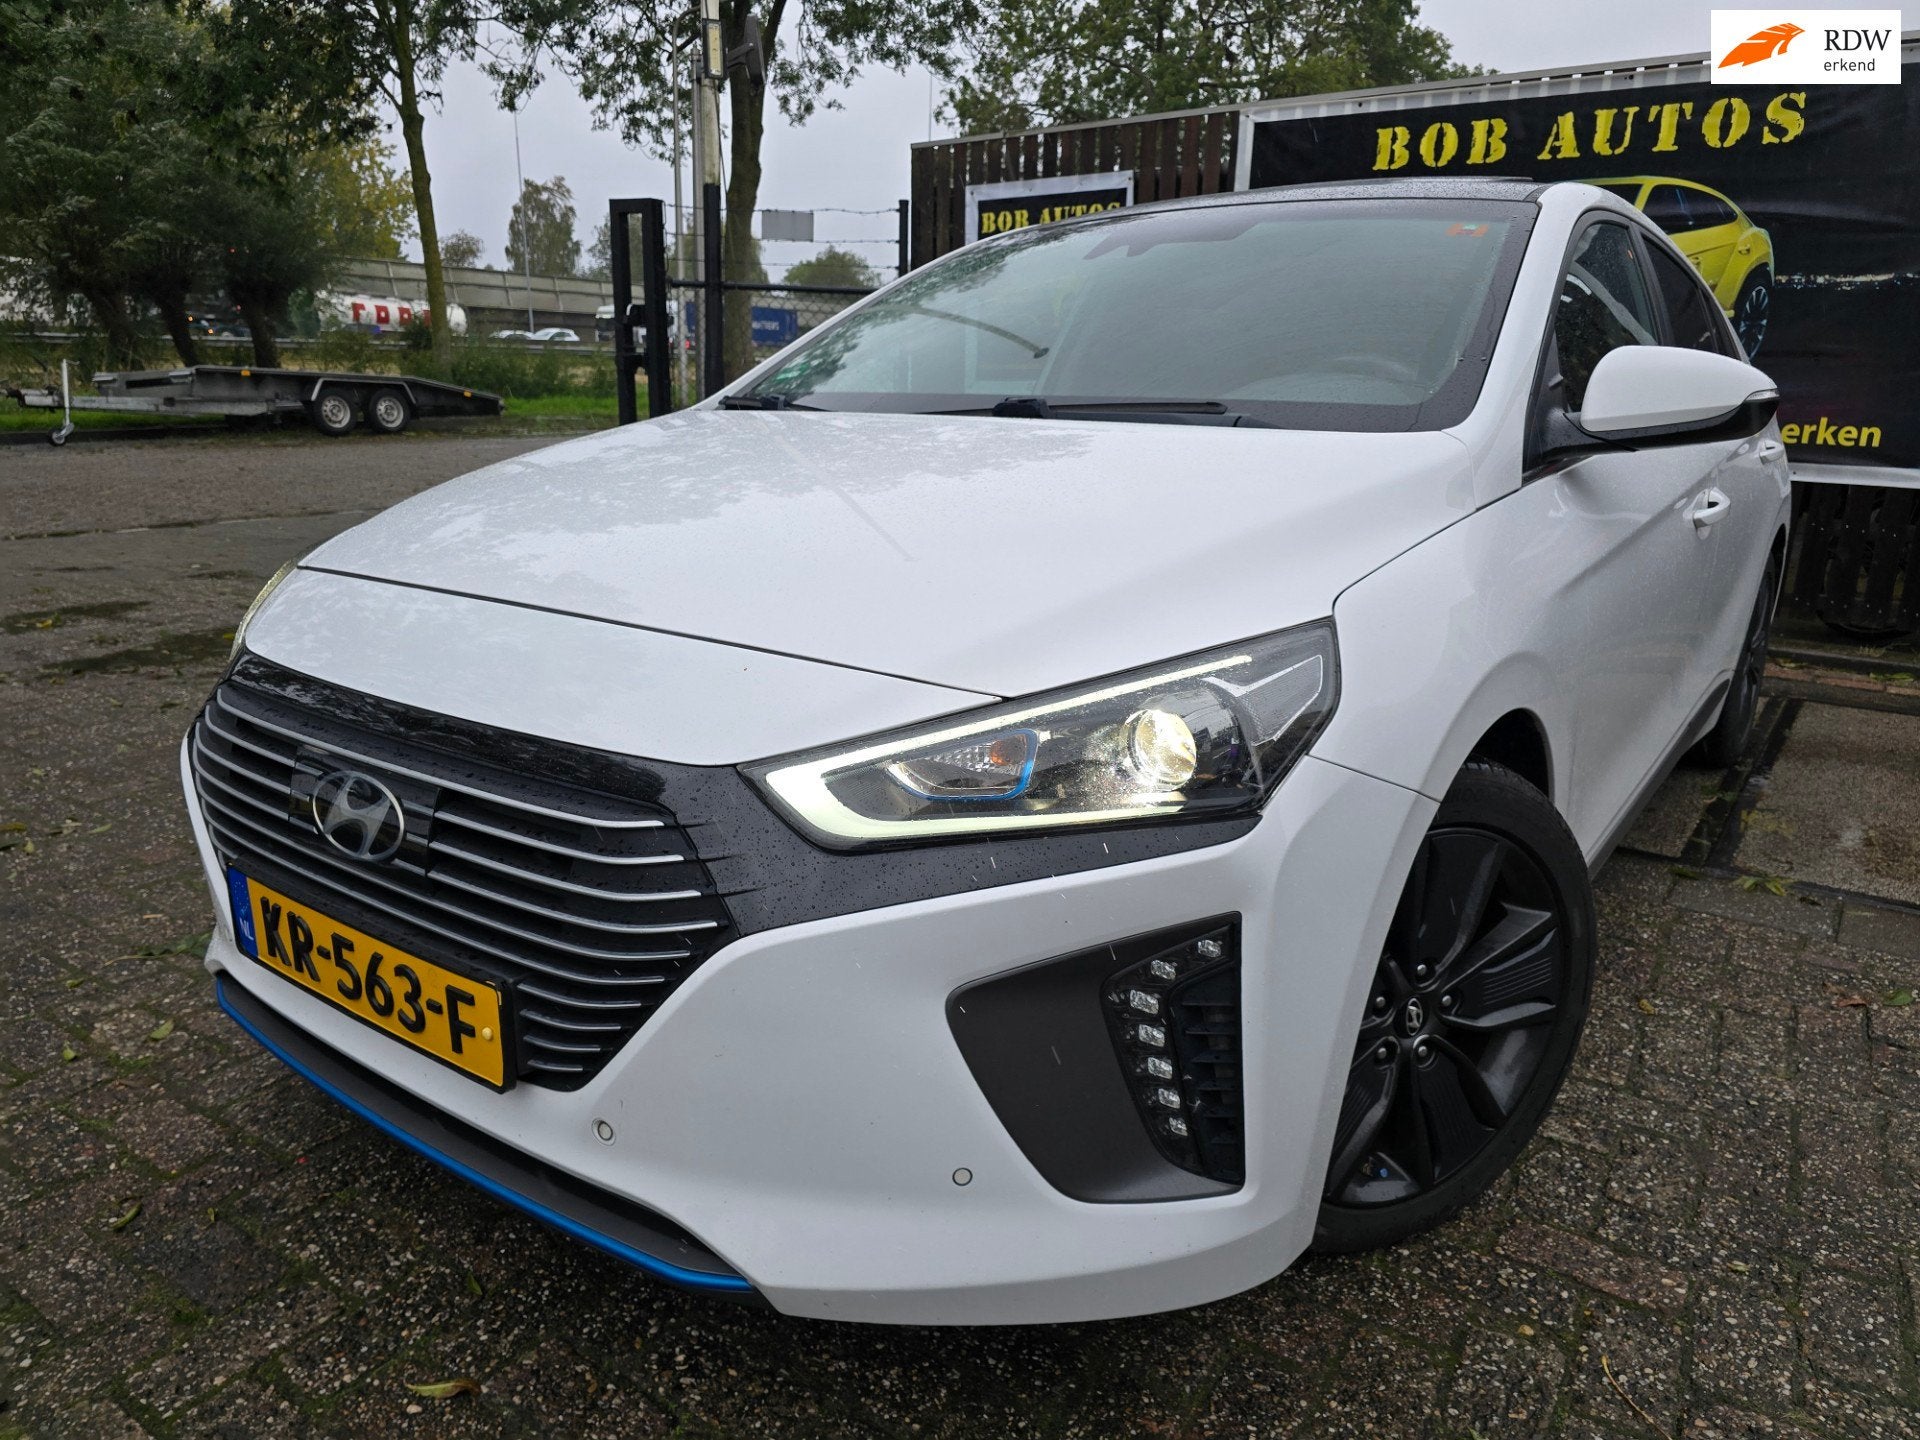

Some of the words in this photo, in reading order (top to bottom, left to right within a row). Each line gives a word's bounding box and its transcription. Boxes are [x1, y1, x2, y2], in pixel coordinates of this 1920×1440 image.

[1372, 118, 1508, 171] BOB
[1537, 91, 1807, 160] AUTOS
[981, 209, 1029, 234] BOB
[239, 917, 254, 940] NL
[260, 896, 476, 1054] KR-563-F
